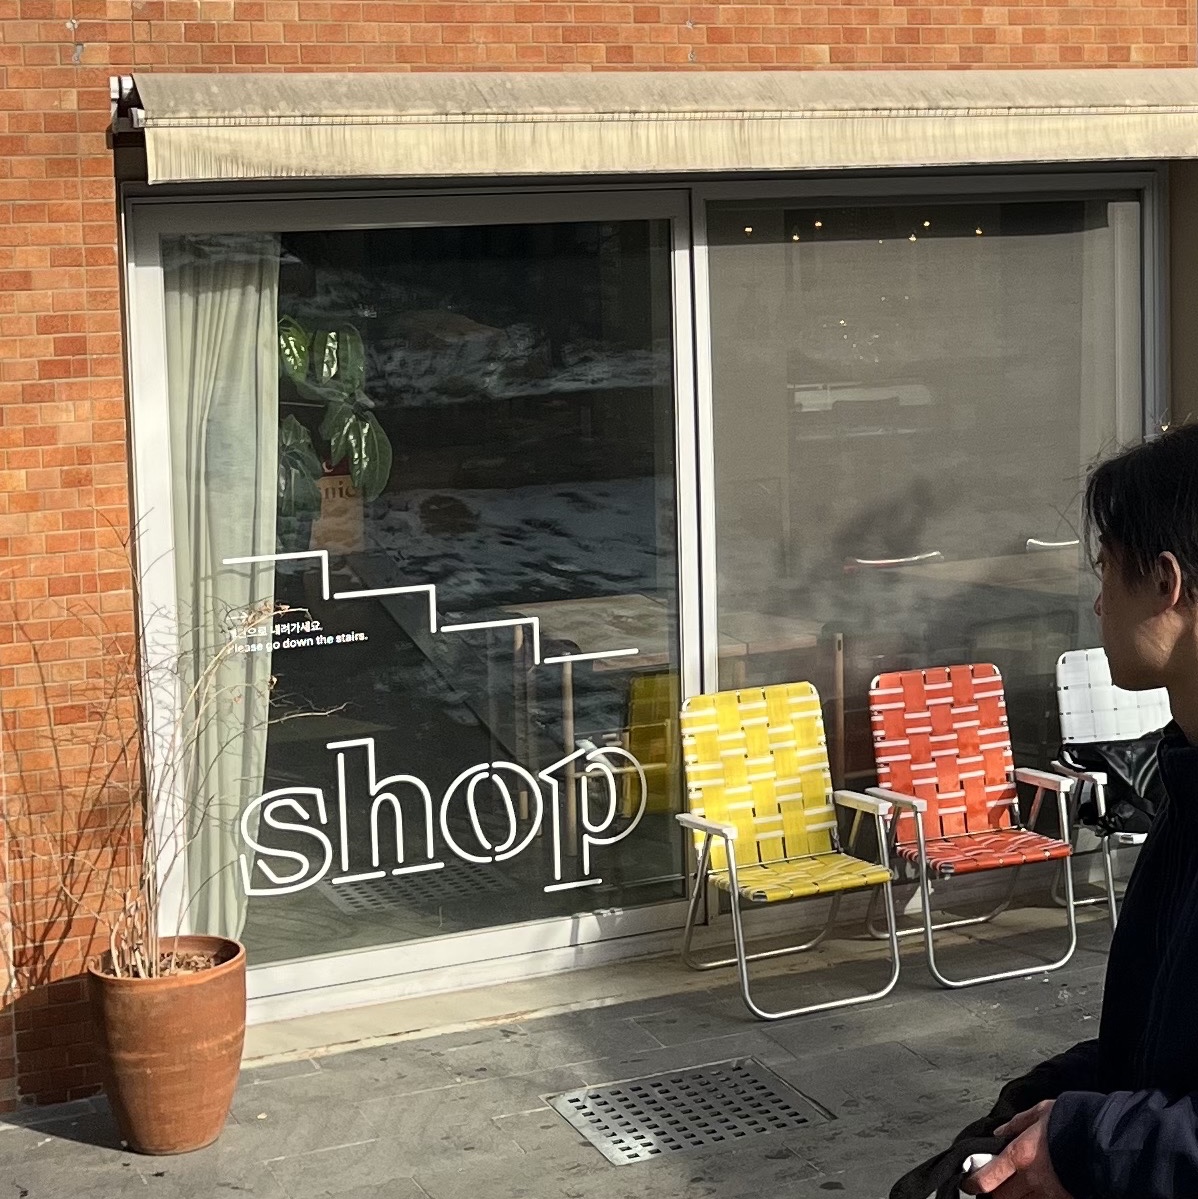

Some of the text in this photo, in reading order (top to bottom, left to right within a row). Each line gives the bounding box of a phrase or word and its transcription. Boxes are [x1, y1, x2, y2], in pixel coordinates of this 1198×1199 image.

[228, 631, 369, 654] lease go down the stairs.
[240, 737, 647, 897] shop
